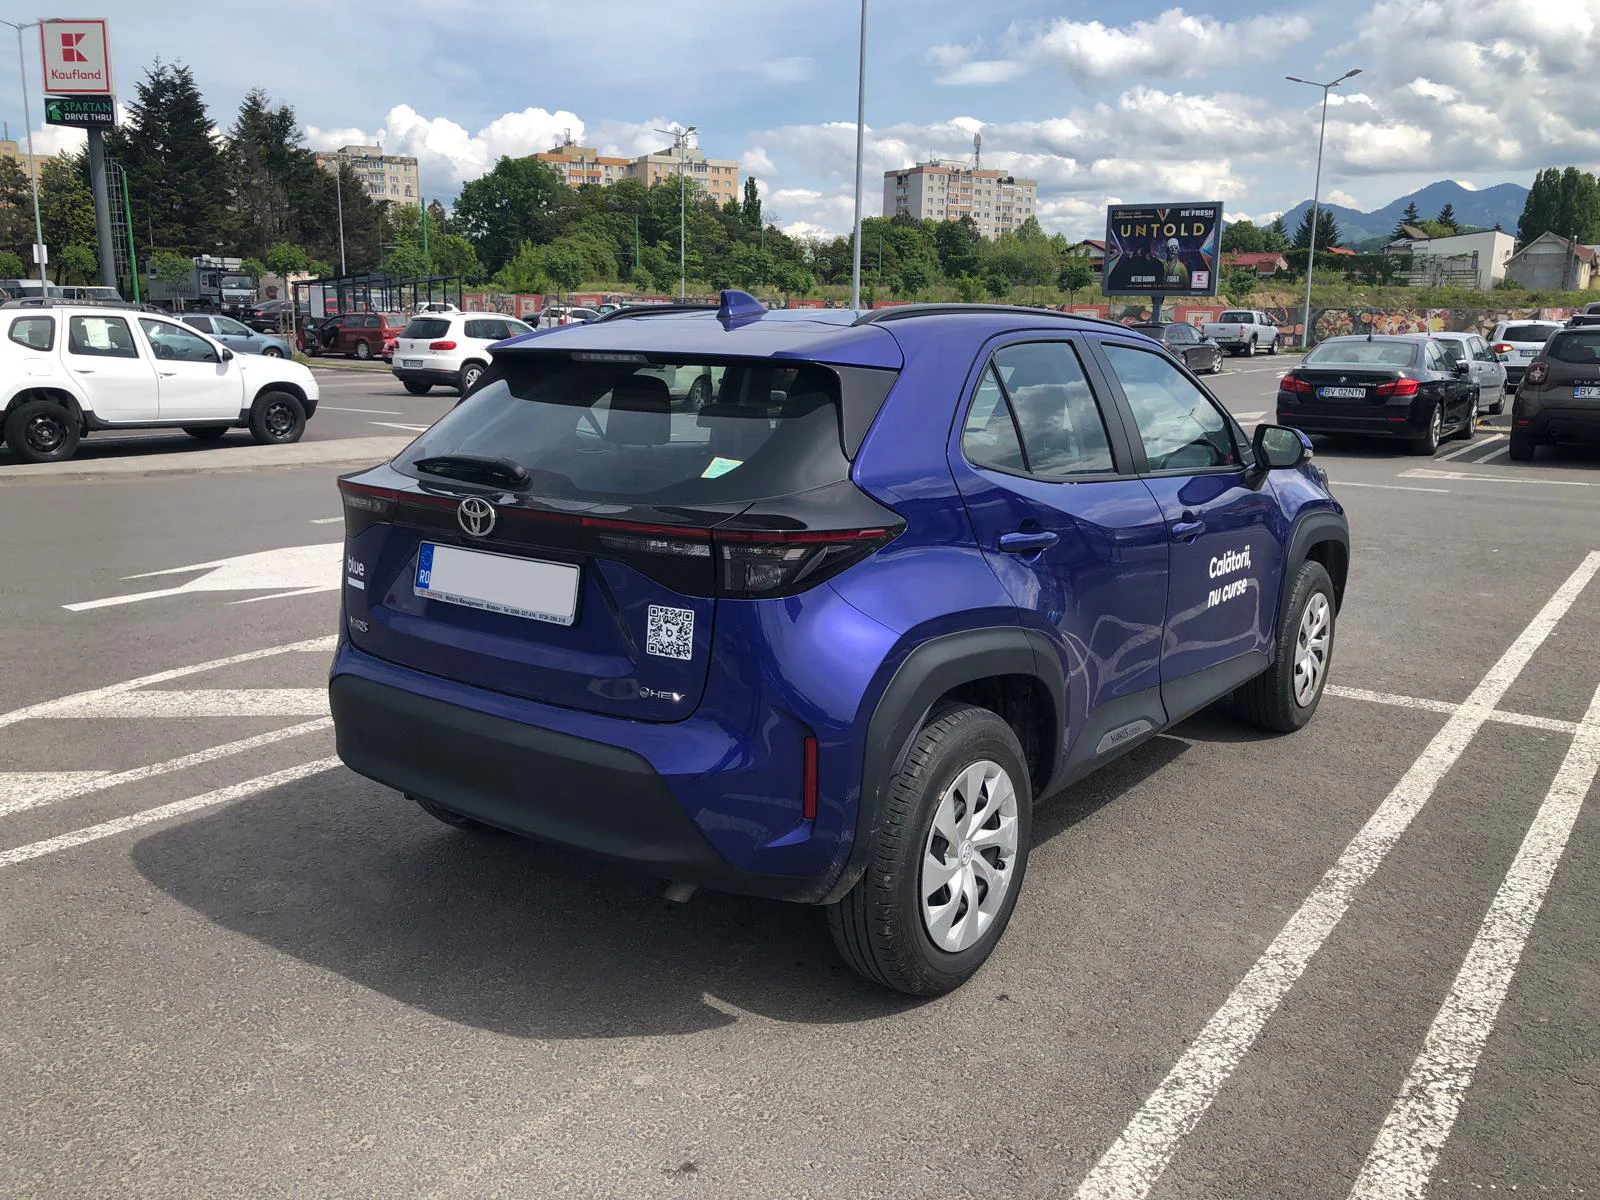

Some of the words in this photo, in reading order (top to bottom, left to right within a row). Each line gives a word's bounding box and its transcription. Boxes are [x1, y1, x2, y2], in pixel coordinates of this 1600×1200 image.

[51, 69, 101, 80] Kaufland
[64, 102, 112, 112] SPARTAN
[64, 113, 89, 121] DRIVE
[90, 113, 112, 121] THRU
[1120, 223, 1205, 238] UNTOLD
[1324, 387, 1336, 396] BV
[1338, 388, 1365, 397] 02NTN
[1580, 388, 1593, 396] BV
[347, 554, 365, 577] blue
[1209, 544, 1252, 579] Calătorii,
[419, 569, 431, 584] RO
[1208, 588, 1222, 609] nu
[1222, 577, 1248, 602] curse
[650, 689, 686, 701] HEV
